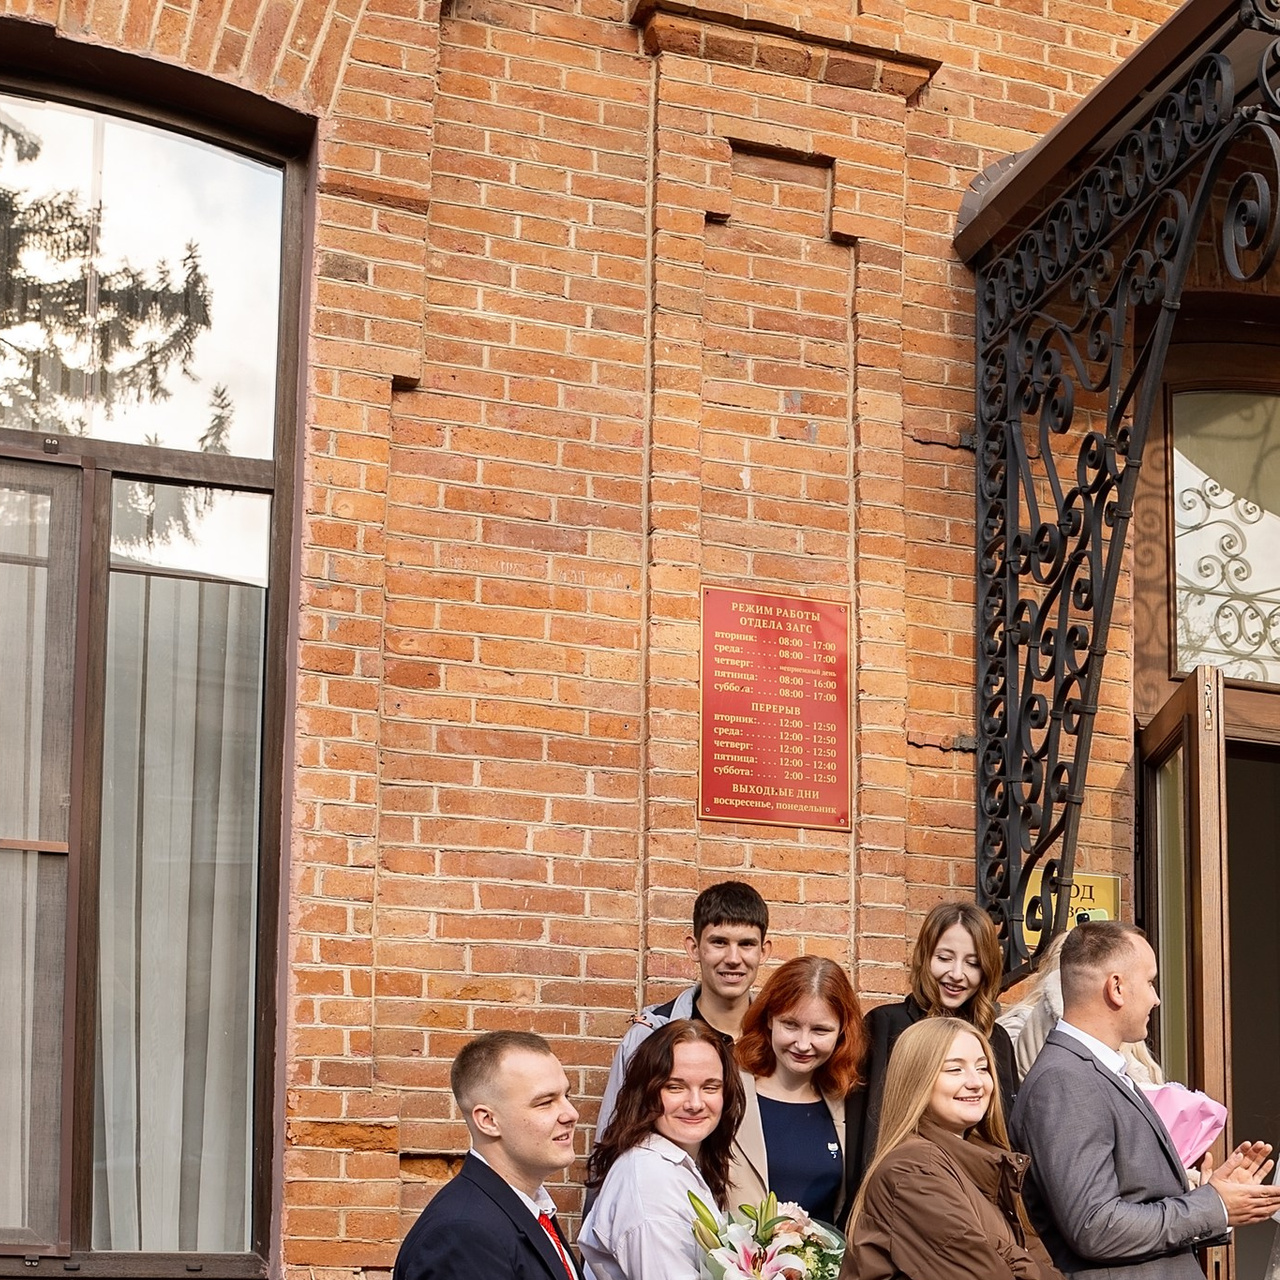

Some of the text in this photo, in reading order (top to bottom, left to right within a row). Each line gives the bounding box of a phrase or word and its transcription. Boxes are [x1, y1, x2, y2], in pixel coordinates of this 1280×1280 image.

[732, 602, 820, 621] РЕЖИМ РАБОТЫ
[740, 617, 812, 634] ОТДЕЛА ЗАГС
[715, 631, 757, 642] вторник:
[778, 636, 802, 647] 08:00
[813, 641, 836, 651] 17:00
[714, 644, 743, 655] среда:
[779, 649, 803, 660] 08:00
[813, 654, 836, 664] 17:00
[714, 657, 753, 668] четверг:
[714, 670, 758, 682] пятница:
[779, 675, 803, 686] 08:00
[813, 680, 836, 689] 16:00
[779, 688, 803, 698] 08:00
[813, 692, 836, 702] 17:00
[752, 702, 801, 715] ПЕРЕРЫВ
[714, 713, 757, 724] вторник:
[779, 718, 802, 728] 12:00
[813, 722, 836, 732] 12:50
[714, 726, 743, 737] среда:
[779, 732, 803, 742] 12:00
[813, 735, 836, 745] 12:50
[714, 739, 753, 751] четверг:
[779, 744, 803, 755] 12:00
[813, 748, 836, 758] 12:50
[714, 752, 758, 764] пятница:
[779, 758, 803, 767] 12:00
[813, 761, 836, 771] 12:40
[714, 765, 753, 776] суббота:
[813, 774, 836, 784] 12:50
[796, 790, 819, 799] ДНИ
[714, 796, 836, 814] воскресенье, понедельник
